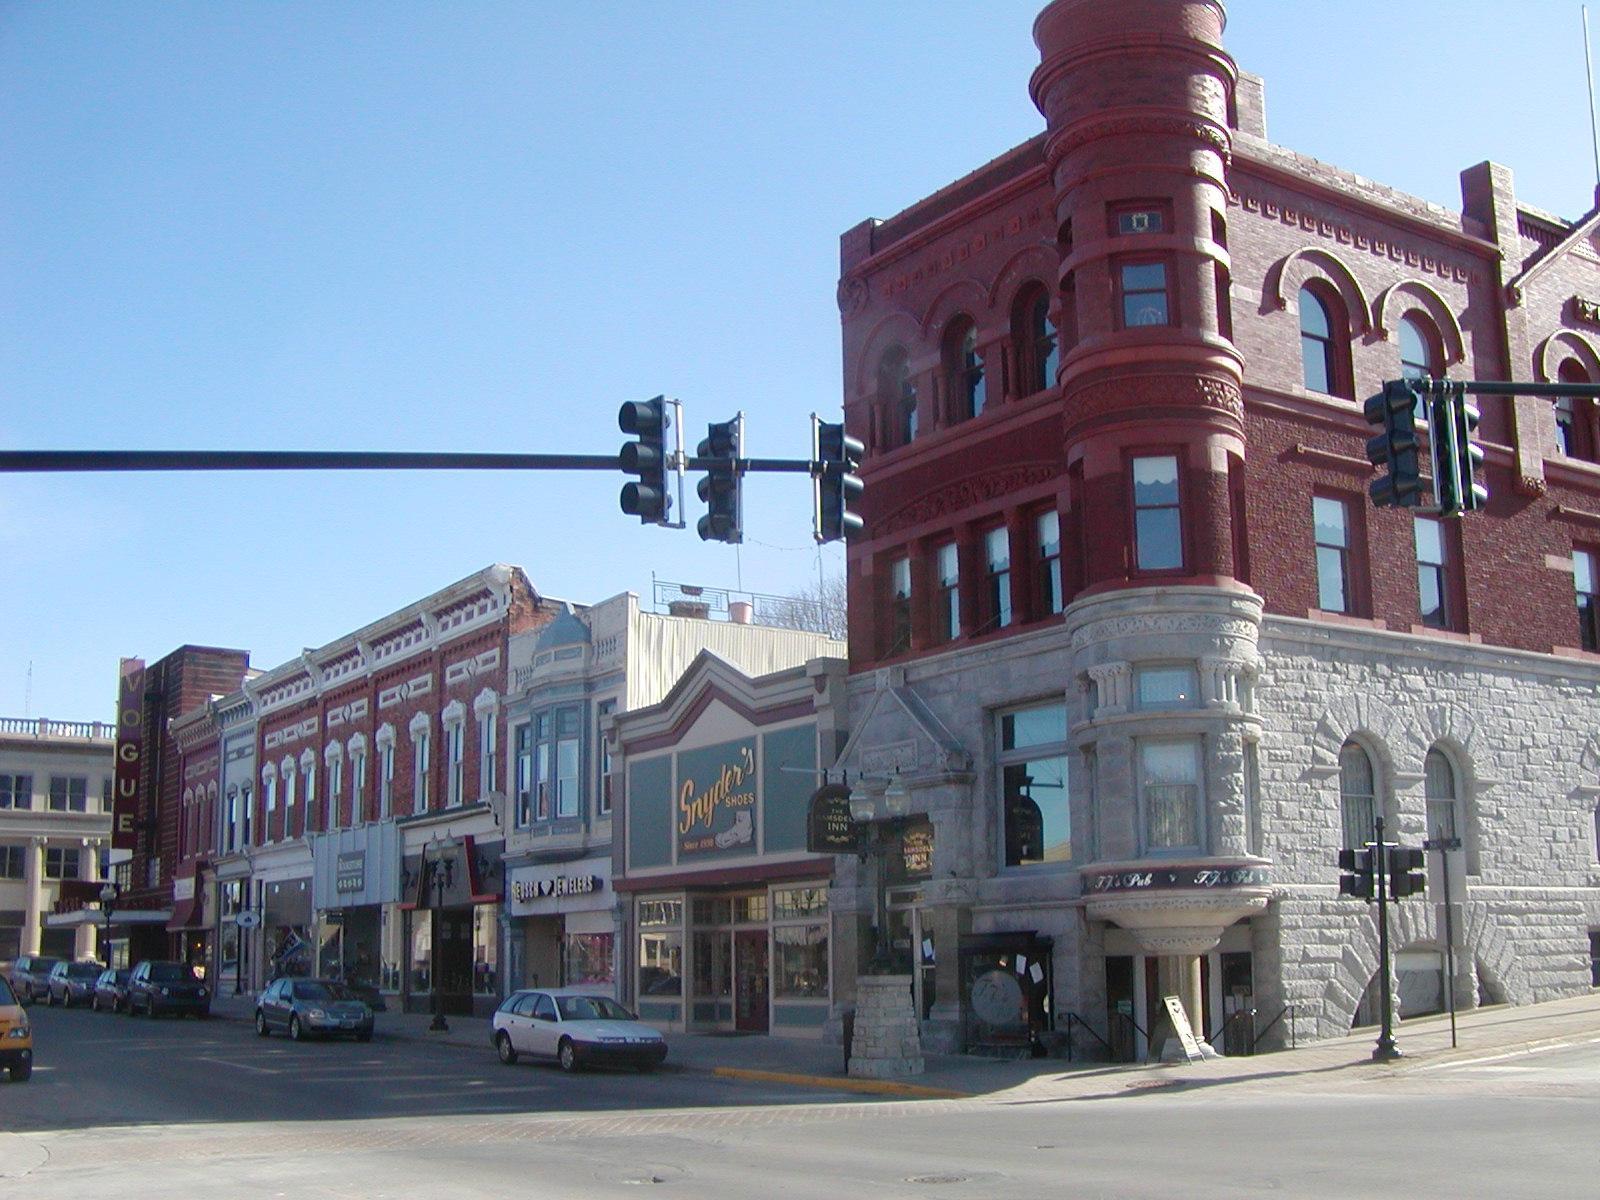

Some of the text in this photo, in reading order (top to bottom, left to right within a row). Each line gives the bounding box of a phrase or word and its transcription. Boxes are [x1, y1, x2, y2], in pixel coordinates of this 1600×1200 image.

[119, 675, 141, 833] VOGUE
[680, 747, 754, 834] Snyder's
[725, 792, 754, 808] SHOES
[827, 822, 848, 832] INN
[552, 875, 593, 898] JEWELERS
[1123, 872, 1153, 888] Pub
